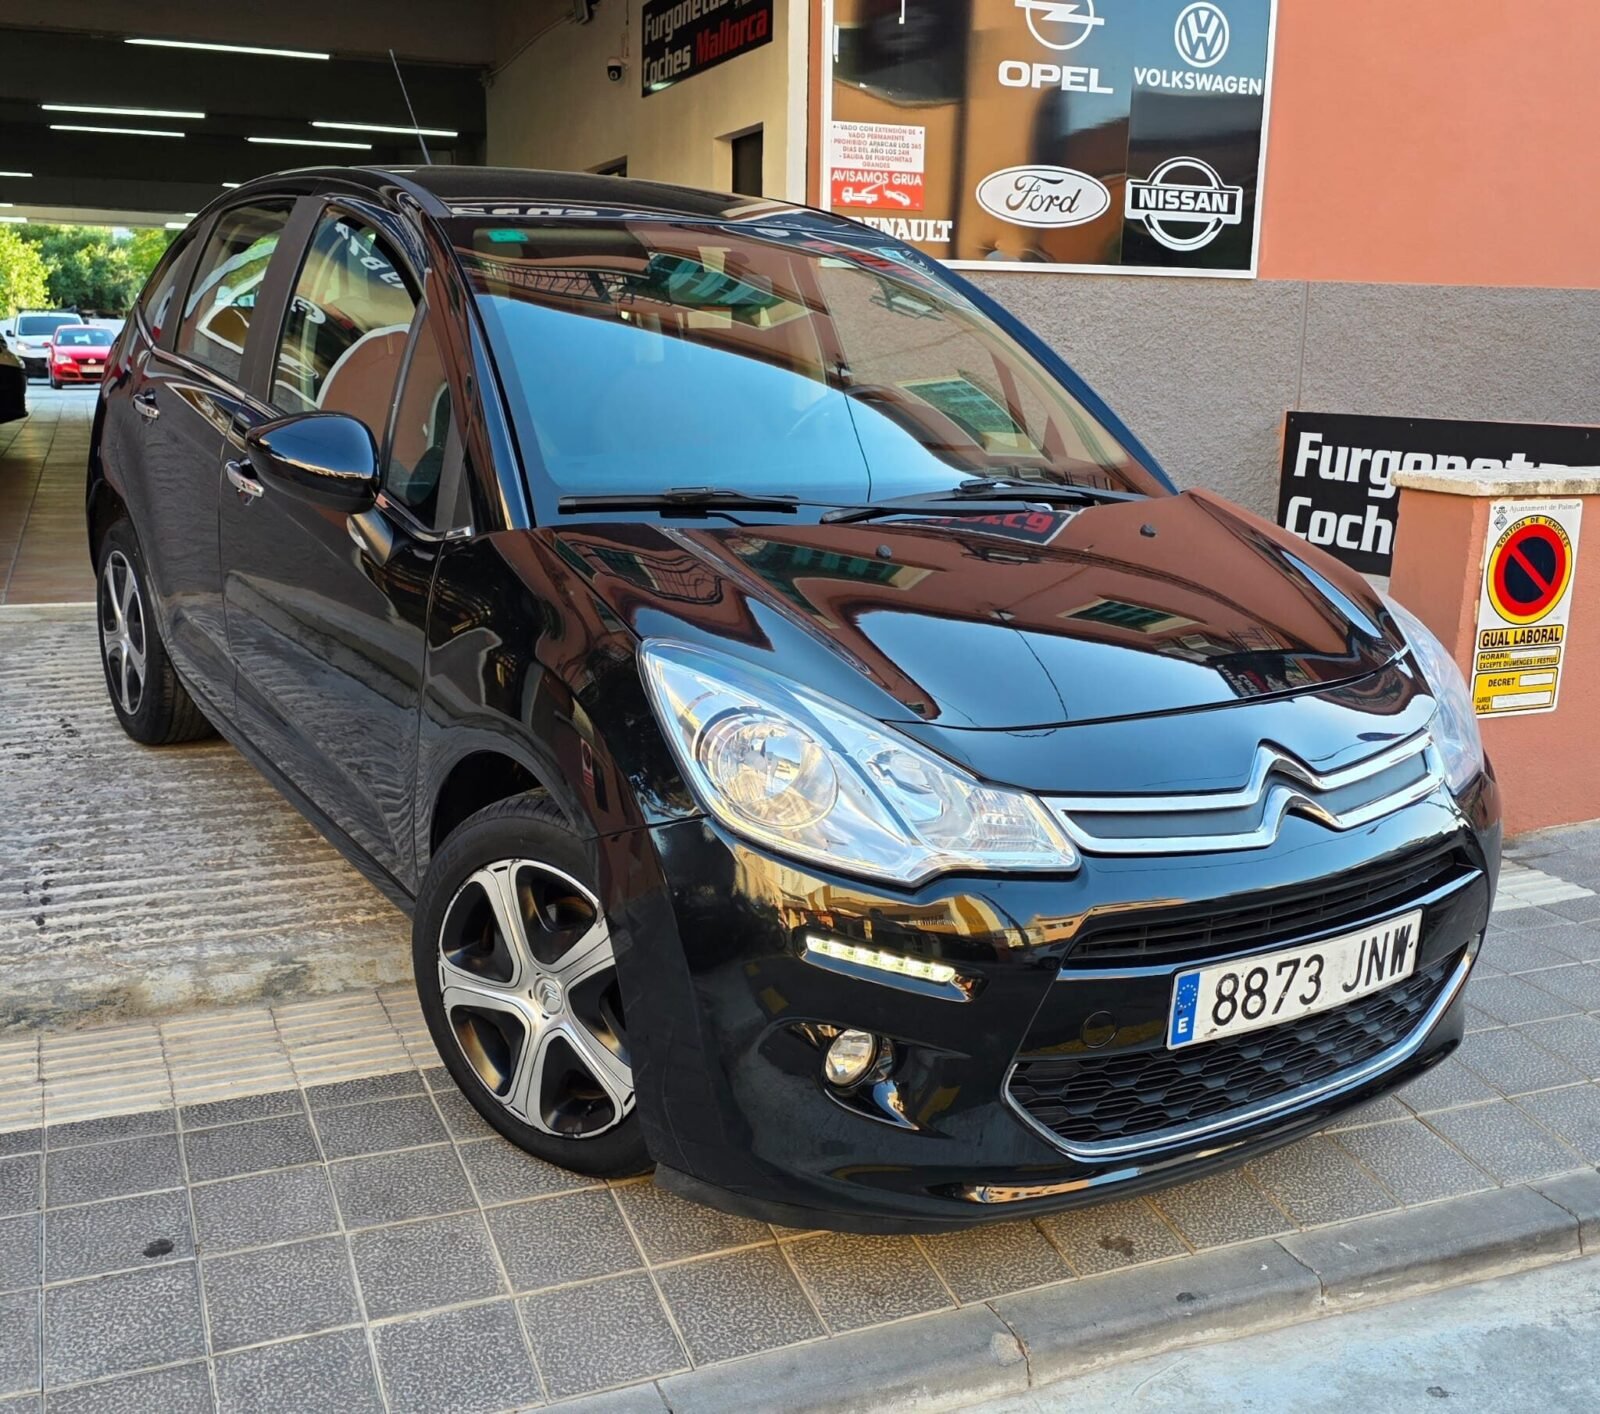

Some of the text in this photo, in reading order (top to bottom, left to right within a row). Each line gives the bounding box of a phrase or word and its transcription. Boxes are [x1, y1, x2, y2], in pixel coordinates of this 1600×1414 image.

[644, 0, 728, 45] Furgone
[643, 9, 768, 88] Coches Mallorca
[998, 60, 1114, 95] OPEL
[1133, 66, 1262, 96] VOLKSWAGEN
[833, 138, 868, 146] PROHIBIDO
[868, 140, 897, 148] APARCAR
[867, 133, 905, 141] PERMANENTE
[870, 146, 884, 154] AÑO
[874, 155, 913, 163] FURGONETAS
[862, 161, 891, 169] GRANDES
[832, 169, 922, 186] AVISAMOS GRUA
[1005, 174, 1083, 214] Ford
[1138, 188, 1229, 213] NISSAN
[1293, 431, 1570, 499] Furgo
[1509, 504, 1547, 513] Ajuntament
[1284, 496, 1393, 555] Coch
[1497, 520, 1526, 548] SORTIDA
[1544, 518, 1570, 548] VEHICLES
[1482, 627, 1560, 647] GUAL LABORAL
[1479, 661, 1502, 669] EXCEPTE
[1537, 656, 1557, 664] FESTIUS
[1488, 677, 1516, 687] DECRET
[1211, 923, 1412, 1027] 8873 JNW
[1177, 1017, 1189, 1034] E
